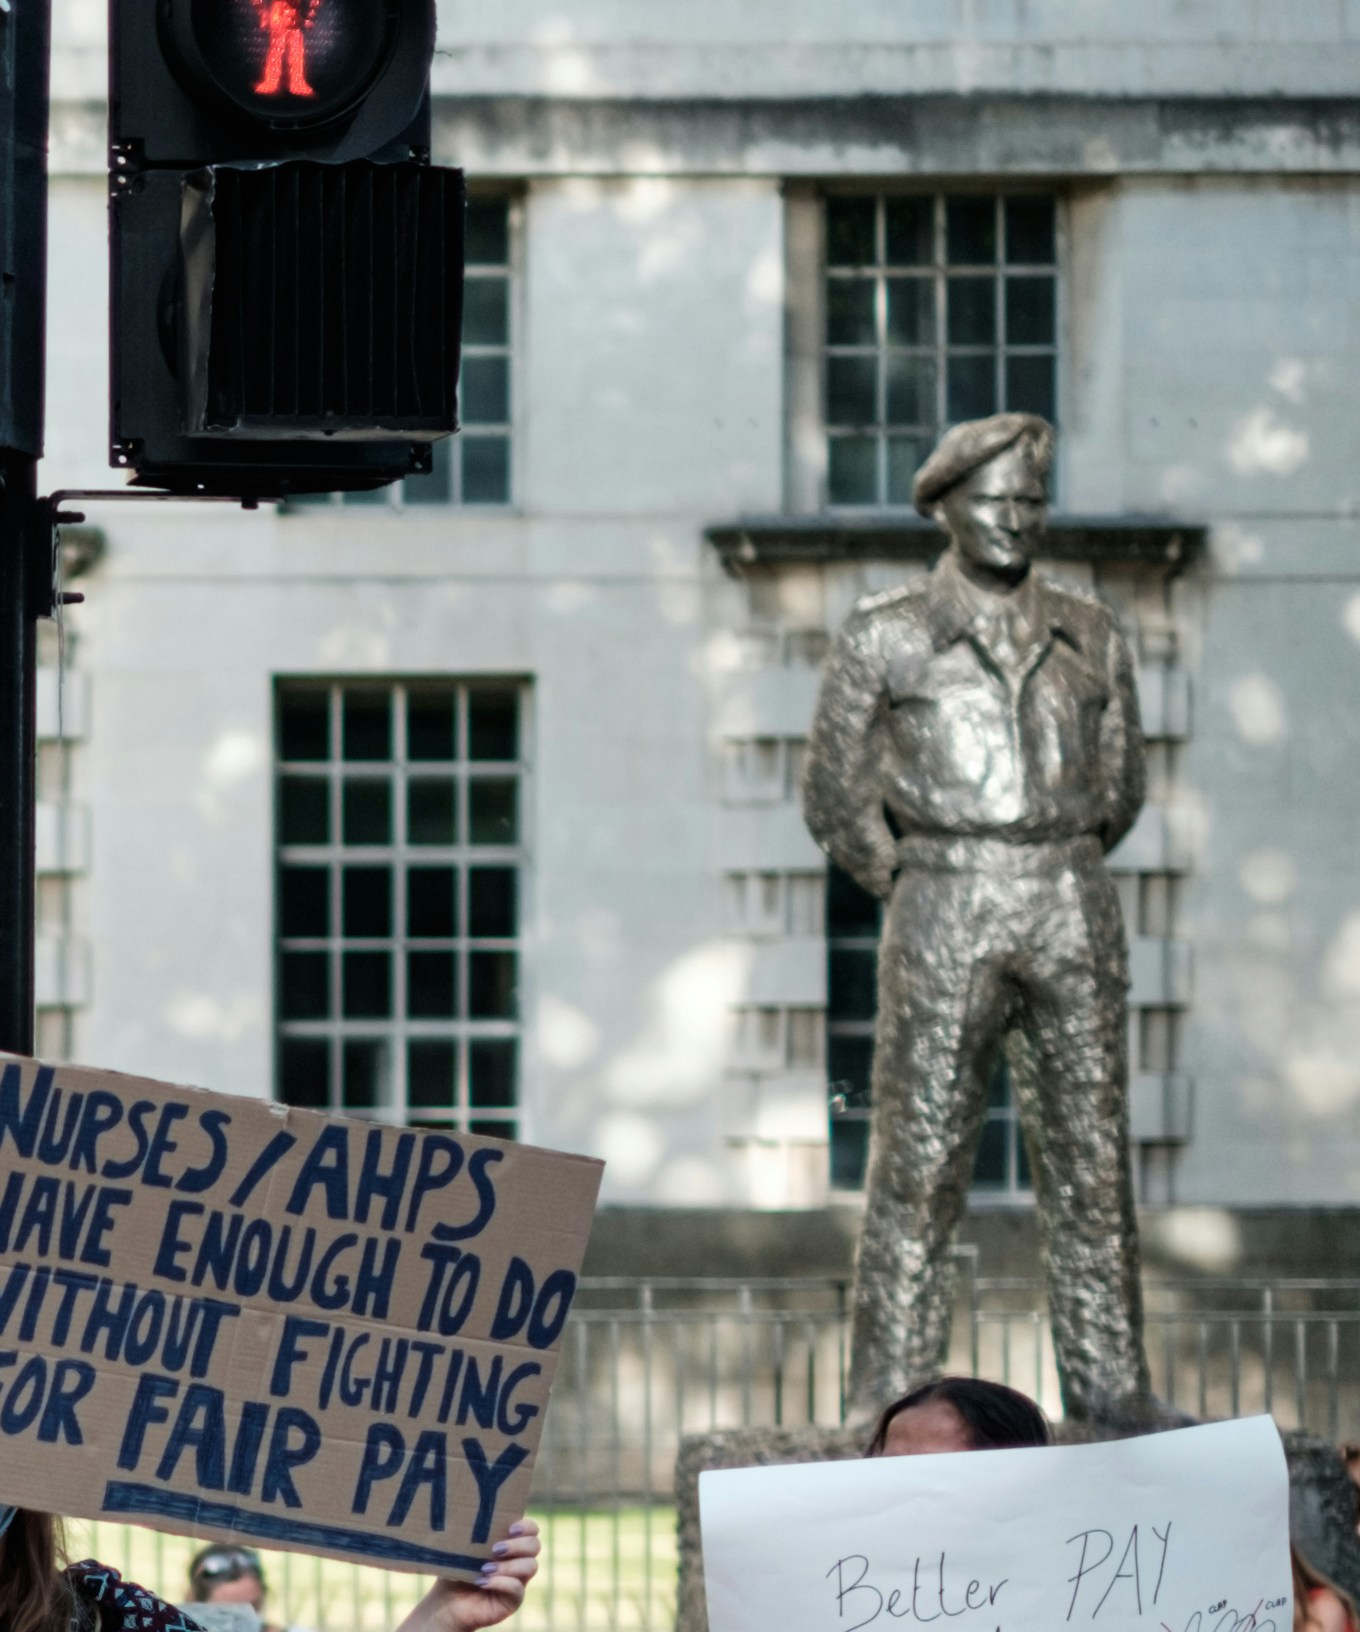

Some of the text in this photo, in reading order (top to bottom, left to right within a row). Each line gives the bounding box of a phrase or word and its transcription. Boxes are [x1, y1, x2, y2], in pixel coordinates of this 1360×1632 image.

[153, 1201, 401, 1321] ENOUGH
[416, 1242, 480, 1337] TO
[490, 1256, 578, 1351] DO
[268, 1314, 542, 1437] FIGHTING
[117, 1372, 322, 1510] FAIR
[351, 1422, 531, 1545] PAY
[1066, 1521, 1172, 1622] PAY
